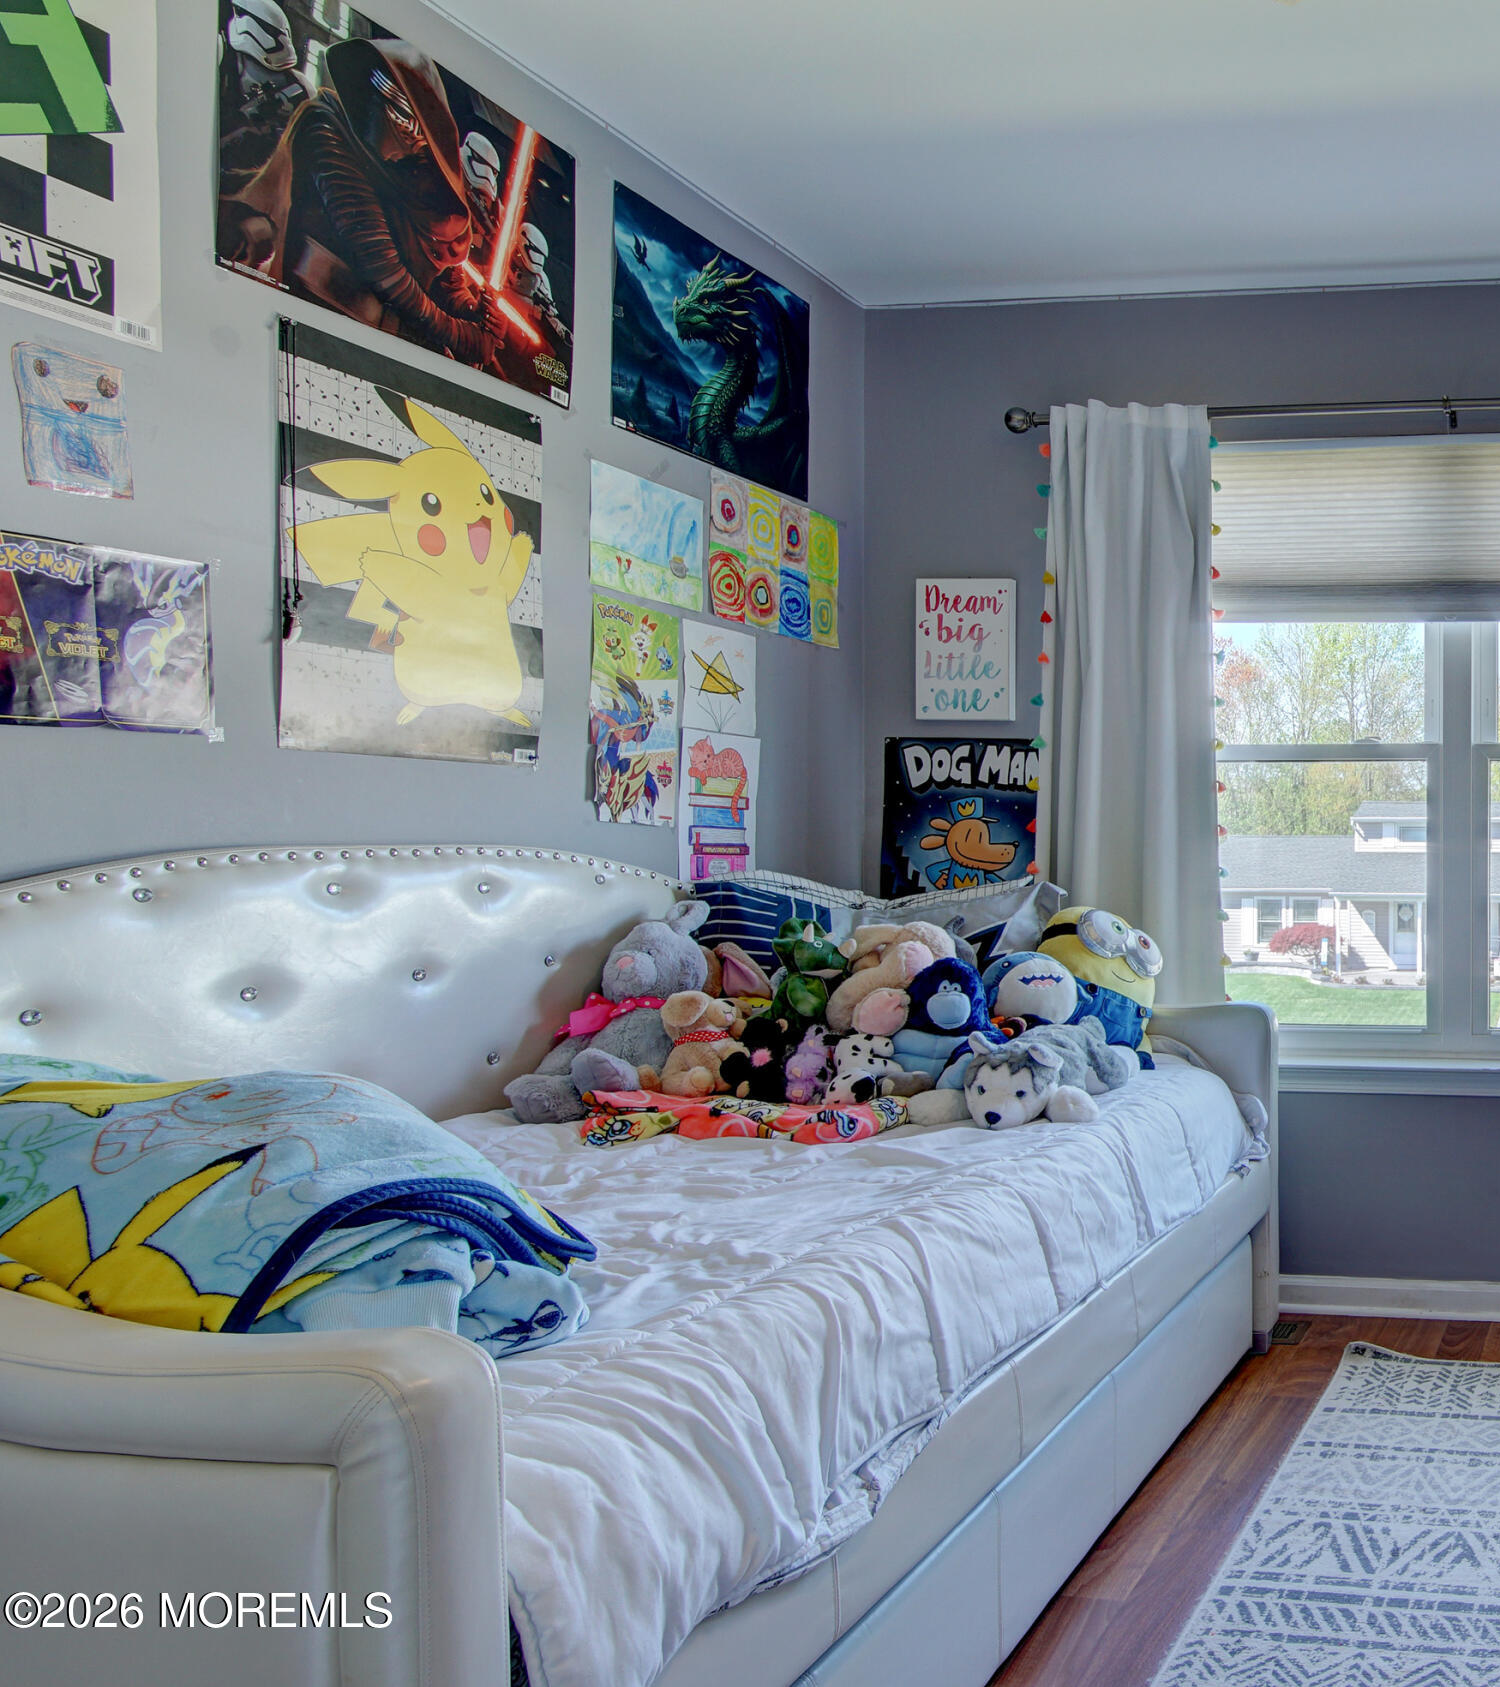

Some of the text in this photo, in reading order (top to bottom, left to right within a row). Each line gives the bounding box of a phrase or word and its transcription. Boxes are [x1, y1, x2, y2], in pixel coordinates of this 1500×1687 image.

[925, 584, 1004, 615] Dream
[936, 613, 991, 653] big
[58, 642, 109, 660] VIOLET
[934, 688, 990, 712] one
[903, 743, 972, 789] DOG
